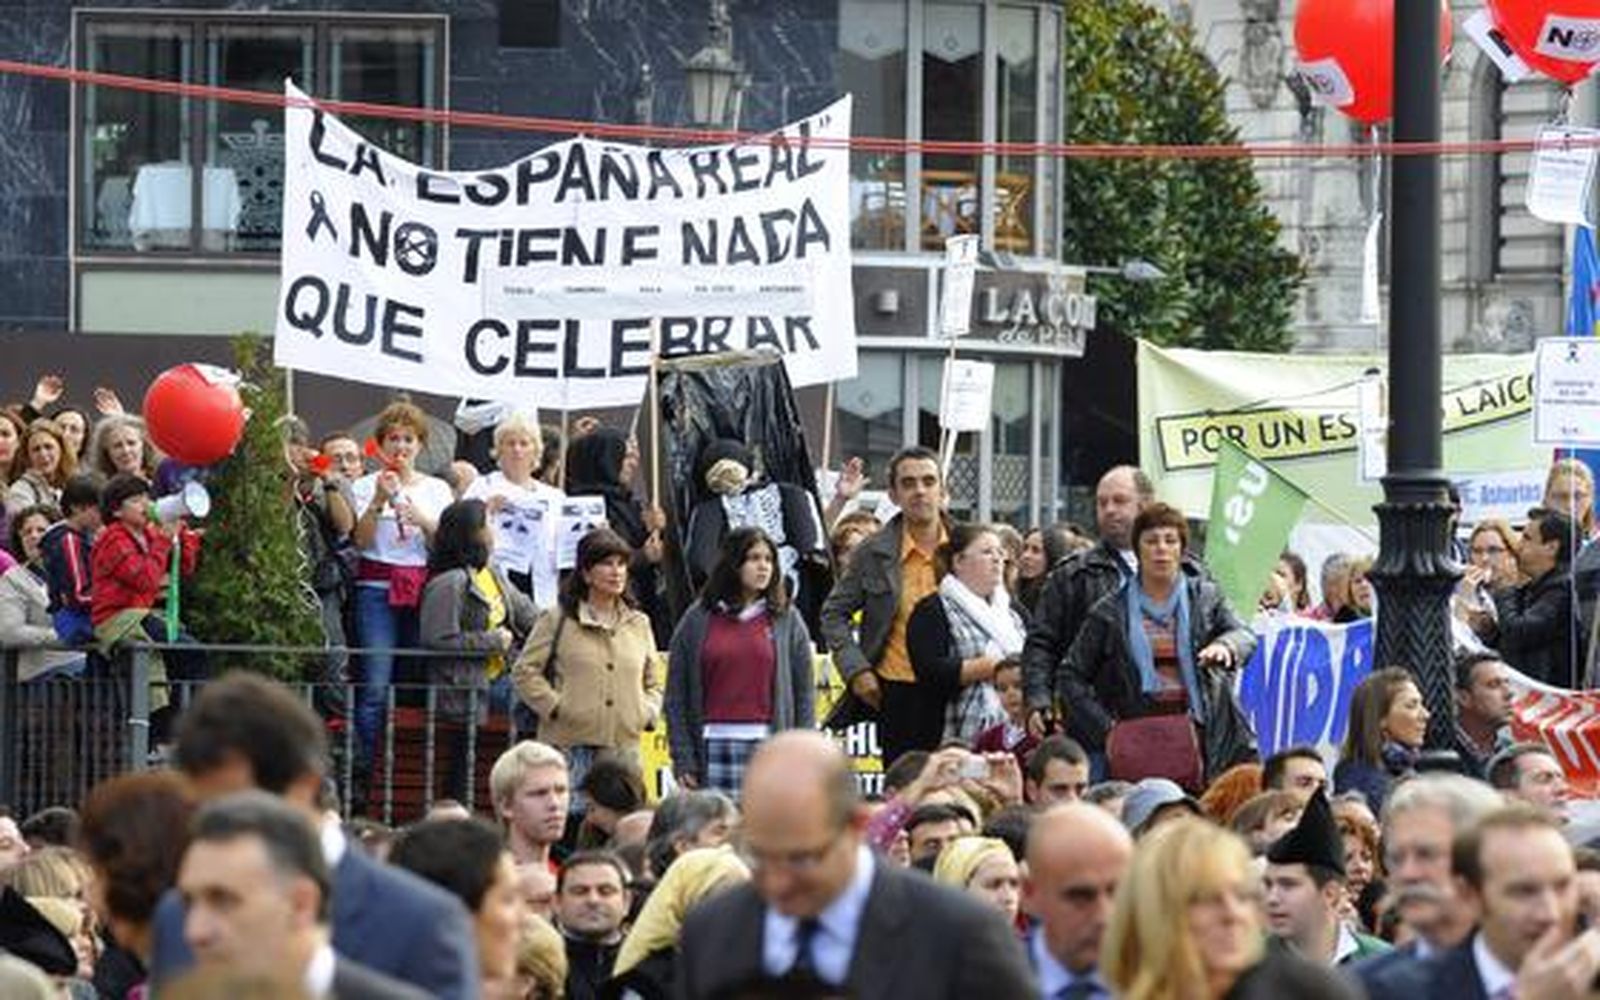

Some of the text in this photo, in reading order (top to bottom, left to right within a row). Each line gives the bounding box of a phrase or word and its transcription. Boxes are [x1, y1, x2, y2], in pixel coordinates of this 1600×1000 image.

[349, 203, 438, 276] NO
[681, 198, 830, 265] NADA
[284, 276, 820, 378] QUE CELEBRAR
[986, 287, 1038, 324] LA
[1181, 423, 1247, 455] POR
[1258, 418, 1306, 448] UN
[1319, 412, 1357, 440] ES
